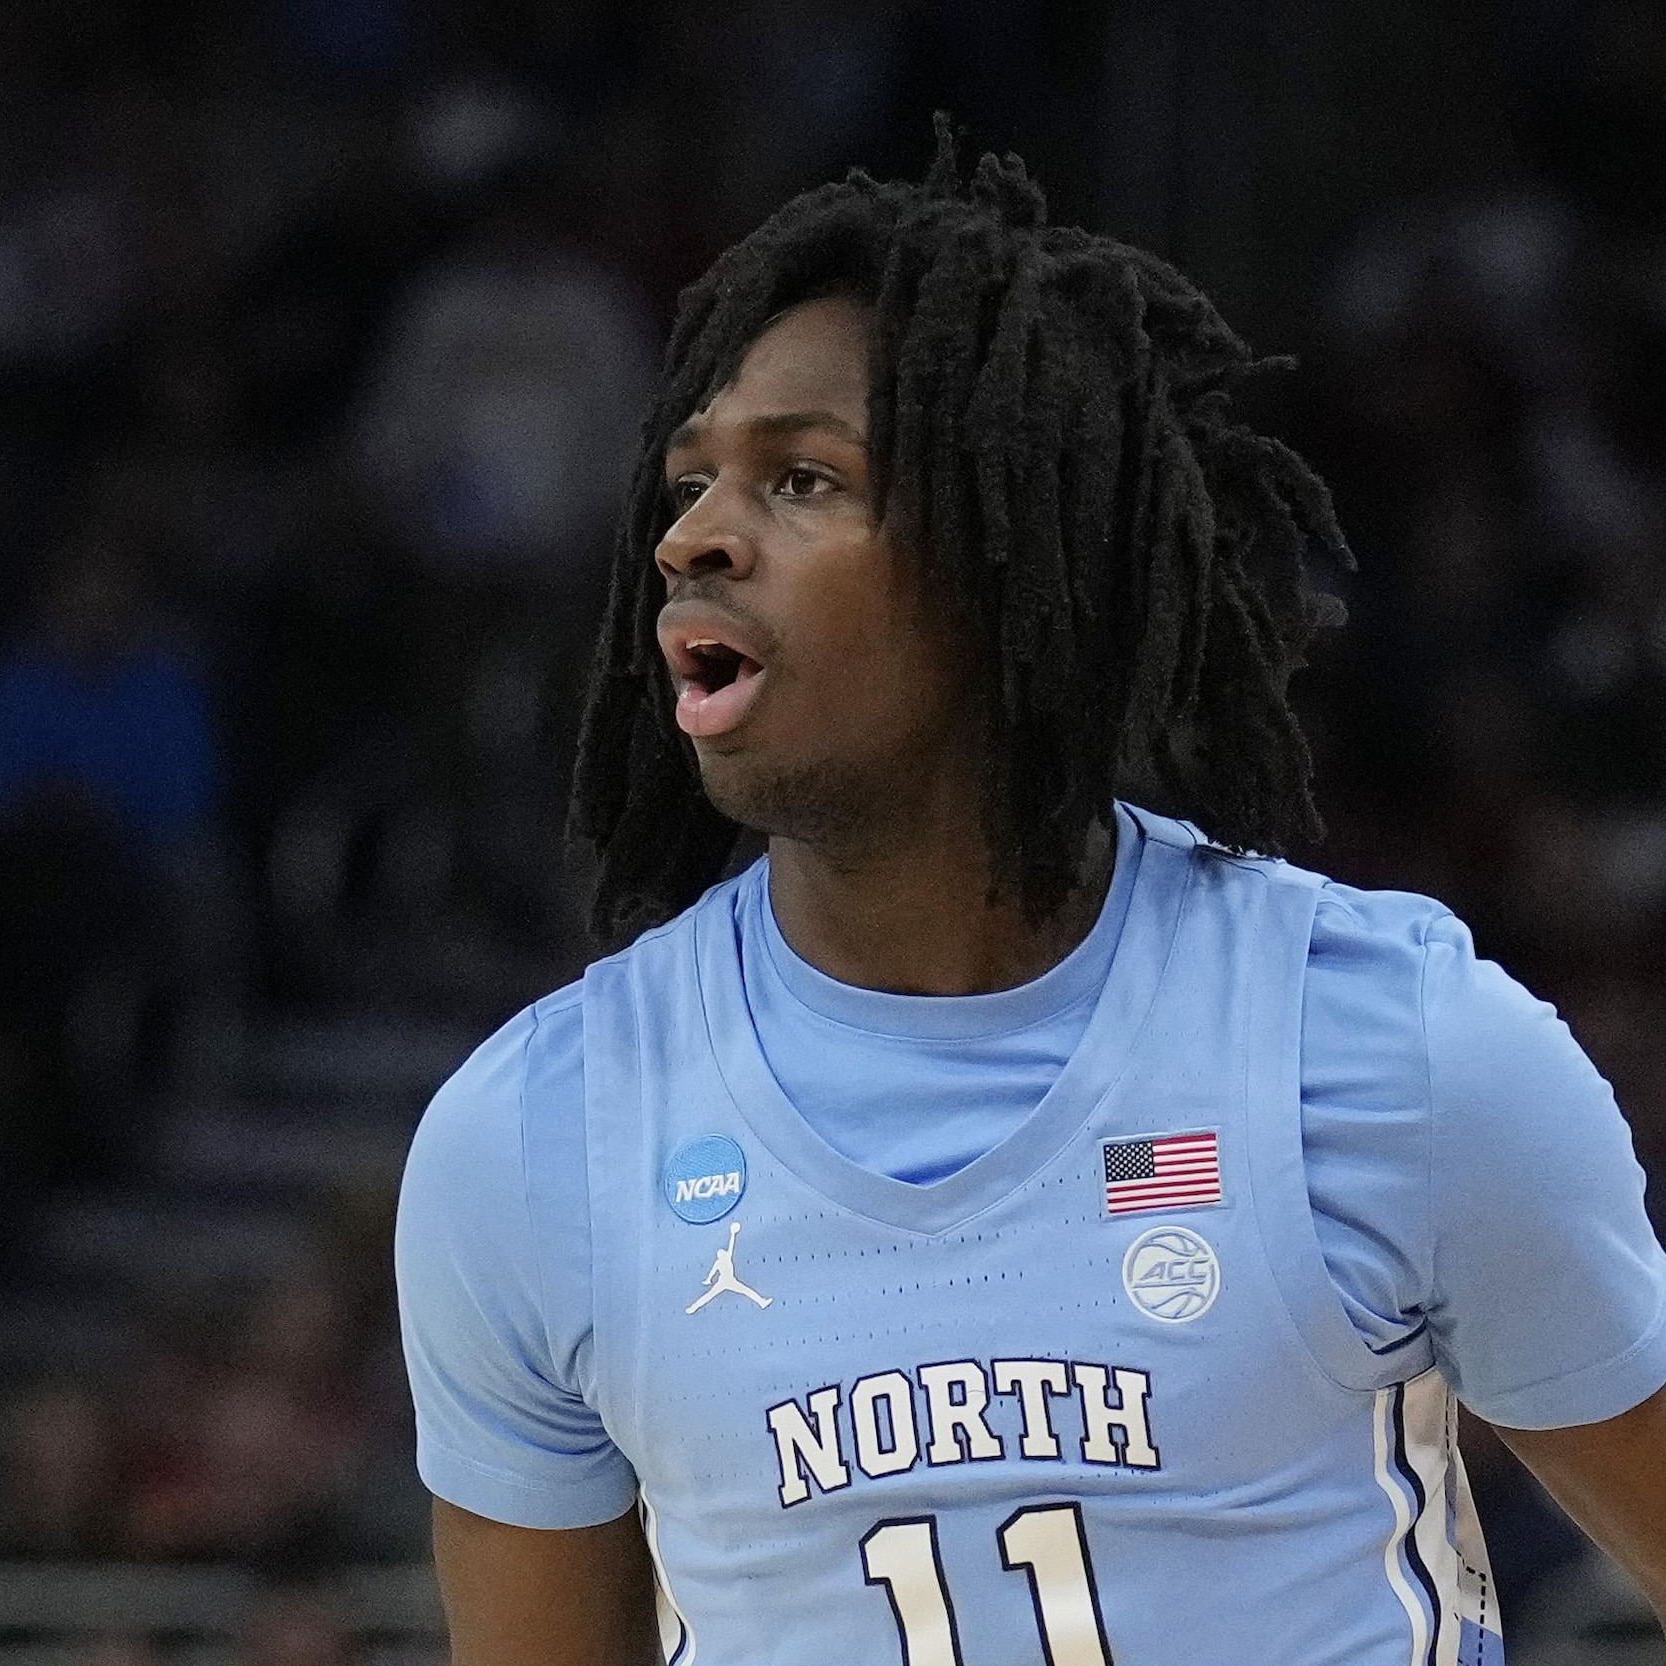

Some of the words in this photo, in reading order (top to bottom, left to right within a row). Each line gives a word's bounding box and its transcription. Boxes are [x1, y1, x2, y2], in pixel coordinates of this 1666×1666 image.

[675, 1171, 740, 1203] NCAA
[1139, 1259, 1209, 1281] ACC
[766, 1358, 1161, 1508] NORTH
